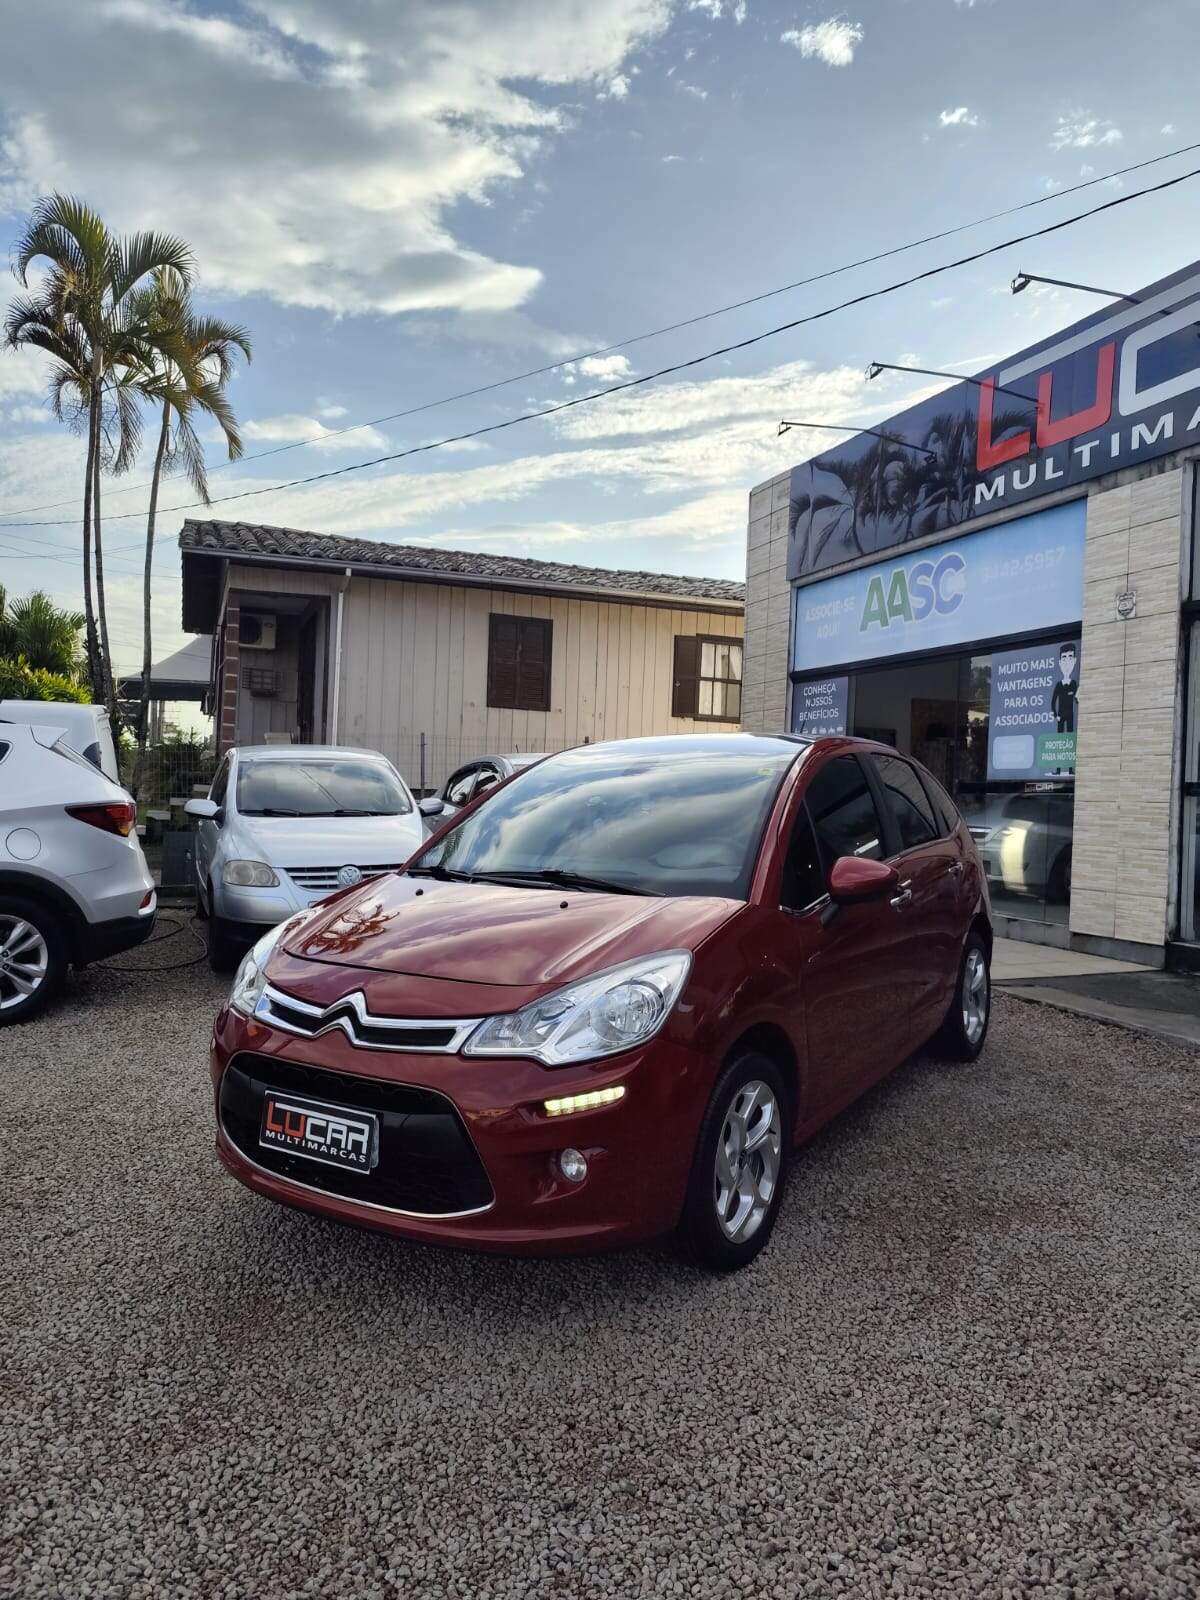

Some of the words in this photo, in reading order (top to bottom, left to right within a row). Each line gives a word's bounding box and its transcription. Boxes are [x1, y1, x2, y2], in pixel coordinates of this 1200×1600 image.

[859, 552, 968, 632] AASC
[998, 661, 1029, 676] MUITO
[1030, 657, 1055, 671] MAIS
[803, 682, 837, 697] CONHEÇA
[997, 675, 1053, 693] VANTAGENS
[1004, 696, 1028, 709] PARA
[1030, 694, 1044, 706] OS
[995, 711, 1055, 727] ASSOCIADOS
[1044, 738, 1074, 751] PROTEÇÃO
[267, 1101, 370, 1155] LUCAR
[265, 1130, 366, 1163] MULTIMARCAS
